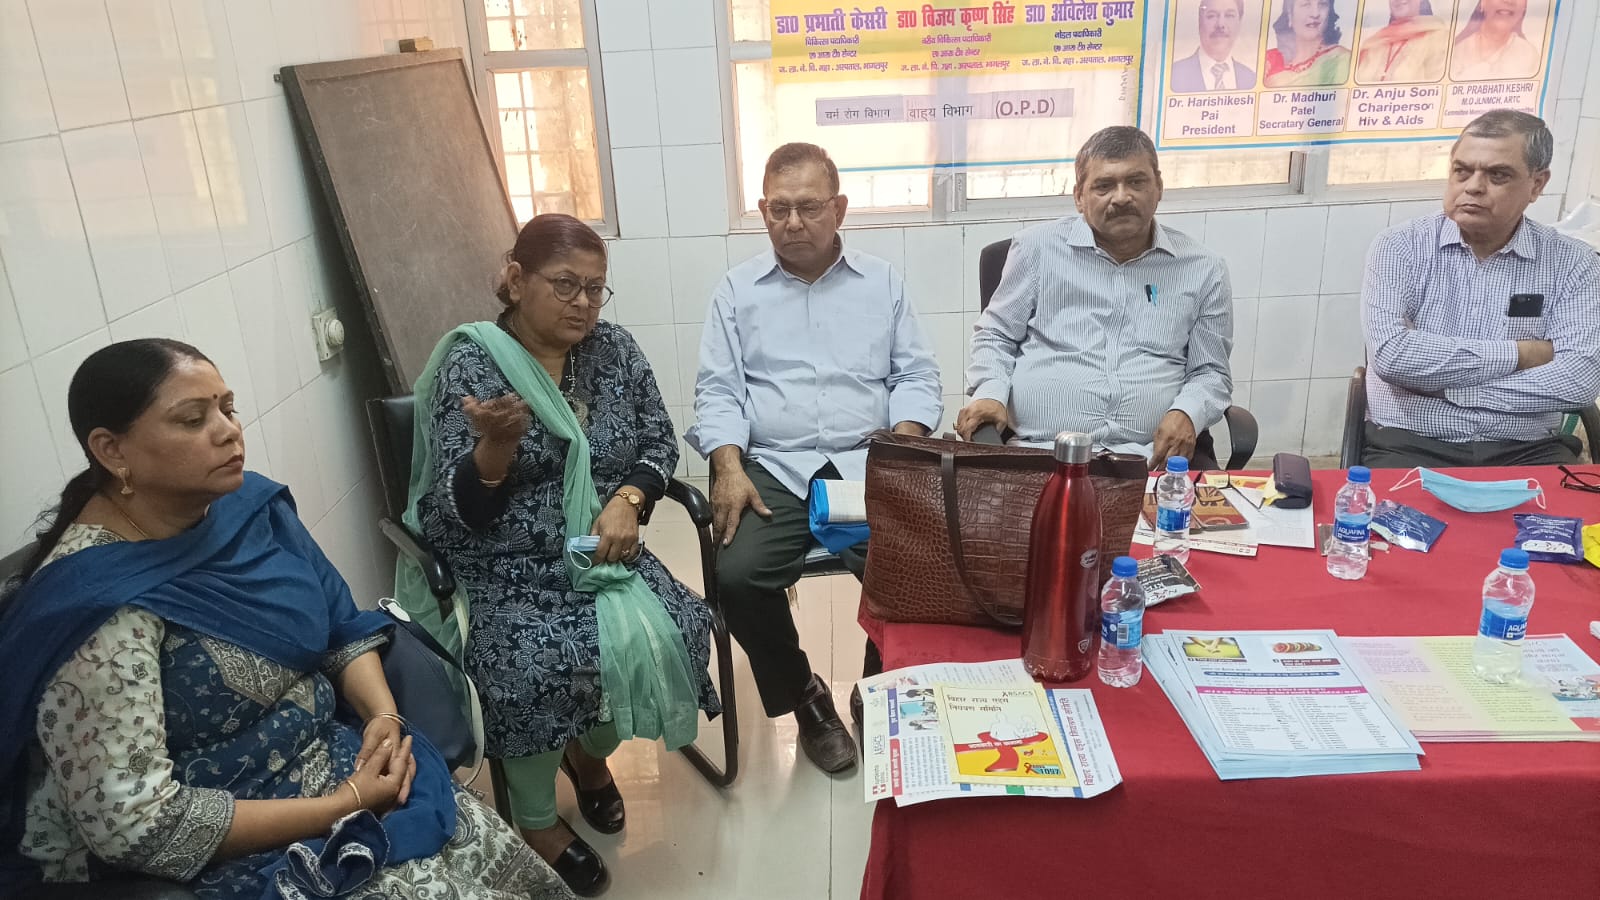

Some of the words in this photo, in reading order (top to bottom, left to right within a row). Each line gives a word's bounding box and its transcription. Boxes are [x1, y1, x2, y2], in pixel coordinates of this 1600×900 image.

[850, 6, 888, 30] केसरी
[922, 4, 956, 27] विजय
[960, 7, 989, 31] कृष्ण
[992, 0, 1016, 24] सिंह
[1102, 1, 1135, 26] कुमार
[1352, 89, 1369, 100] Dr.
[1374, 88, 1405, 100] Anju
[1410, 86, 1439, 98] Soni
[1452, 86, 1464, 95] DR.
[1466, 84, 1504, 94] PRABHATI
[1506, 82, 1534, 92] KESHRI
[1169, 98, 1184, 108] Dr.
[1188, 94, 1254, 107] Harishikesh
[1273, 93, 1288, 104] Dr.
[1291, 90, 1337, 102] Madhuri
[824, 108, 839, 119] चर्म
[844, 108, 860, 118] रोग
[864, 107, 890, 118] विभाग
[942, 104, 974, 118] विभाग
[996, 97, 1055, 119] (O.P.D)
[1290, 106, 1316, 116] Patel
[1358, 102, 1434, 113] Chariperson
[1201, 110, 1219, 120] Pai
[1358, 116, 1378, 126] Hiv
[1382, 116, 1392, 126] &
[1396, 114, 1424, 125] Aids
[1182, 124, 1236, 136] President
[1260, 120, 1304, 130] Secratary
[1308, 117, 1344, 128] General
